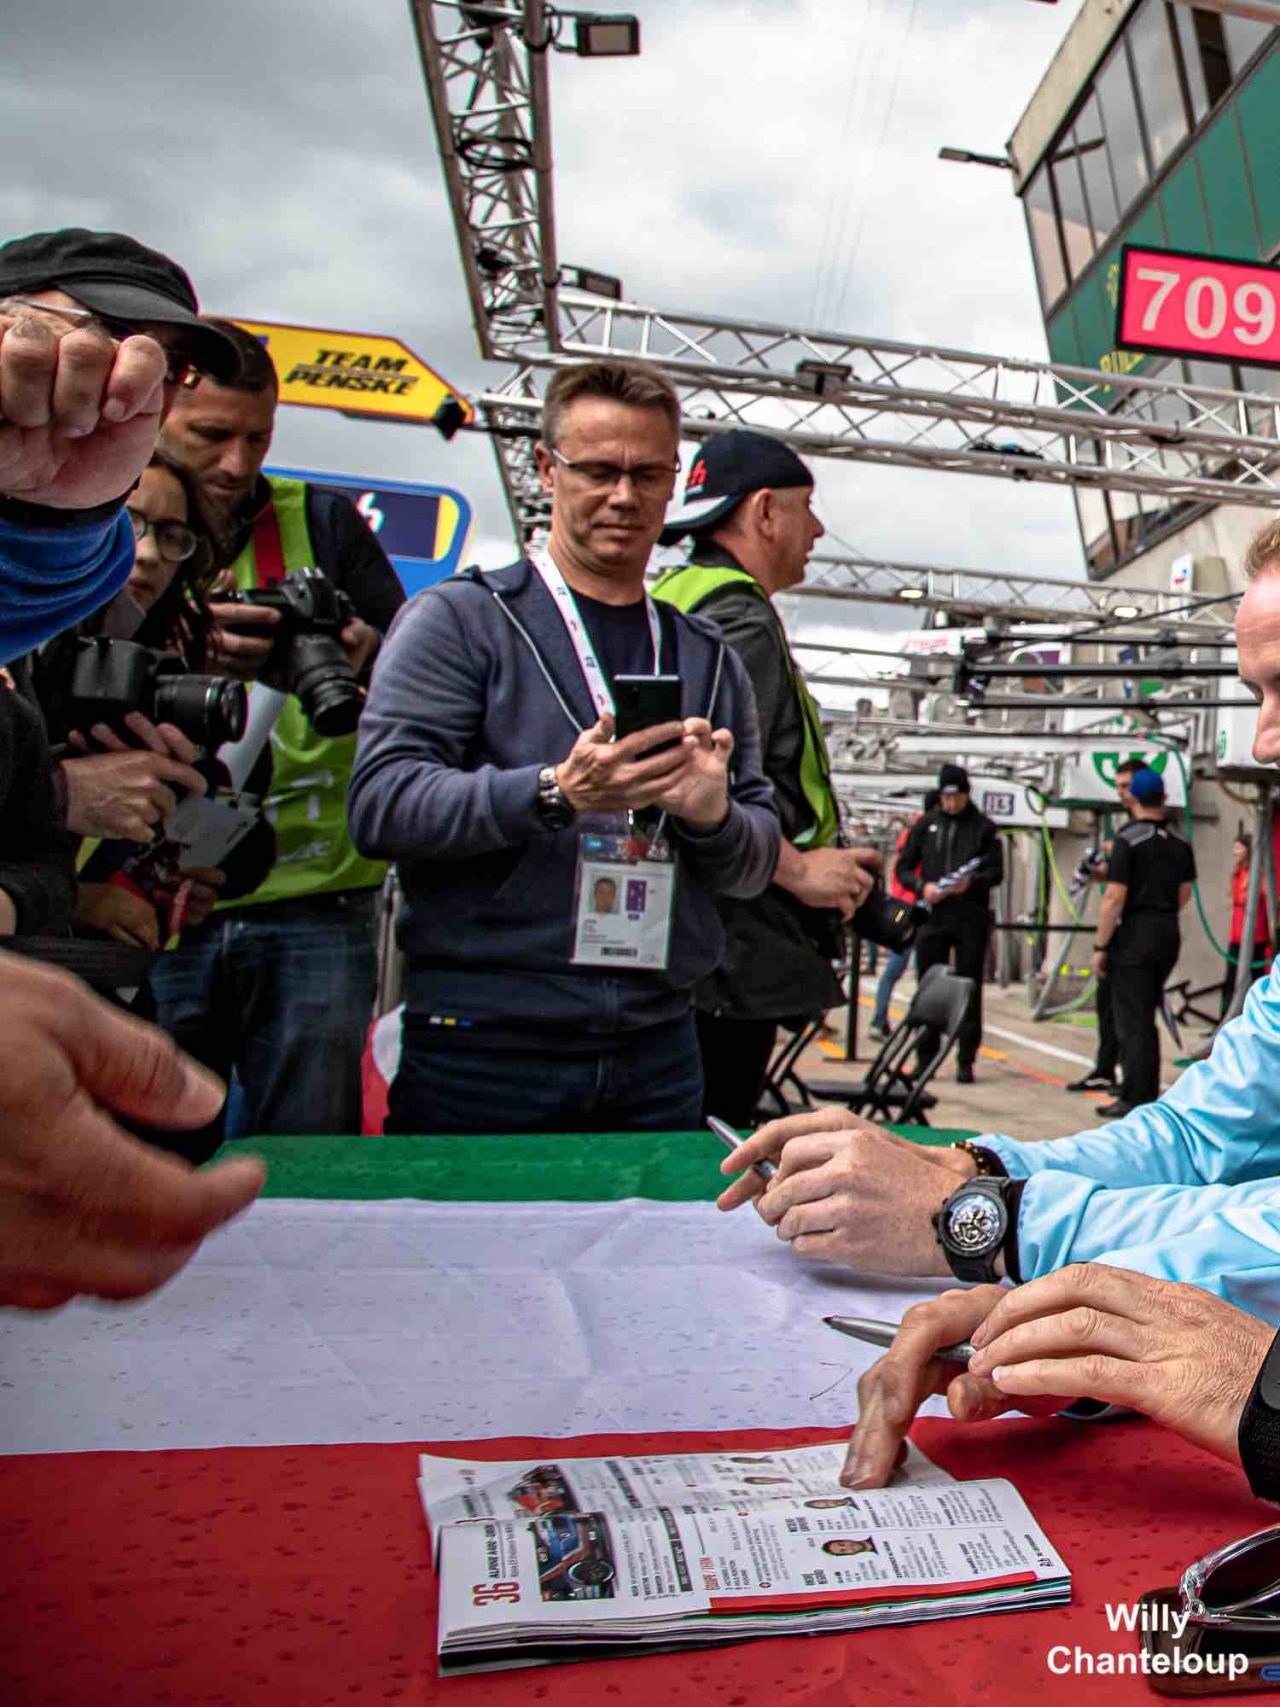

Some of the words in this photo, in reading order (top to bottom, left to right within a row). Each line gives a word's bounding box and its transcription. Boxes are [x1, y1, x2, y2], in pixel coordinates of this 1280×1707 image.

[1137, 267, 1275, 345] 709
[316, 350, 408, 371] TEAM
[284, 370, 412, 395] PENSKE
[472, 1582, 520, 1606] 36
